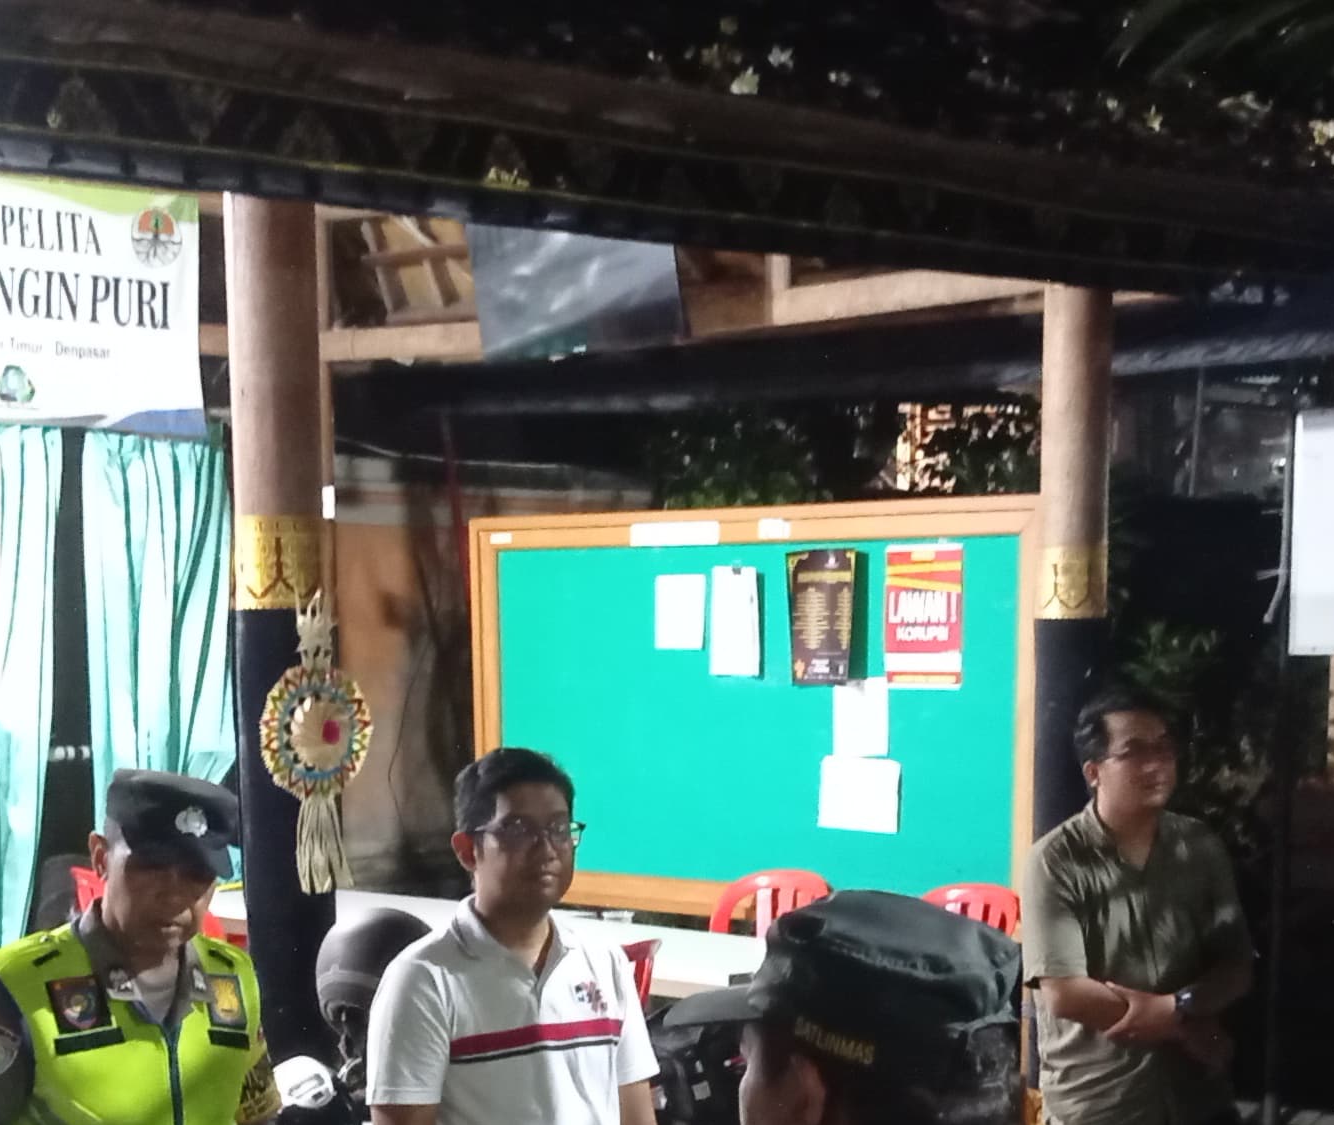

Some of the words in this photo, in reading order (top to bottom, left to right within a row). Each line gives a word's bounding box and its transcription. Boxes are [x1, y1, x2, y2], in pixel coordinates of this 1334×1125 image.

[0, 203, 103, 257] PELITA
[89, 274, 171, 331] PURI
[54, 340, 111, 359] Denpasar
